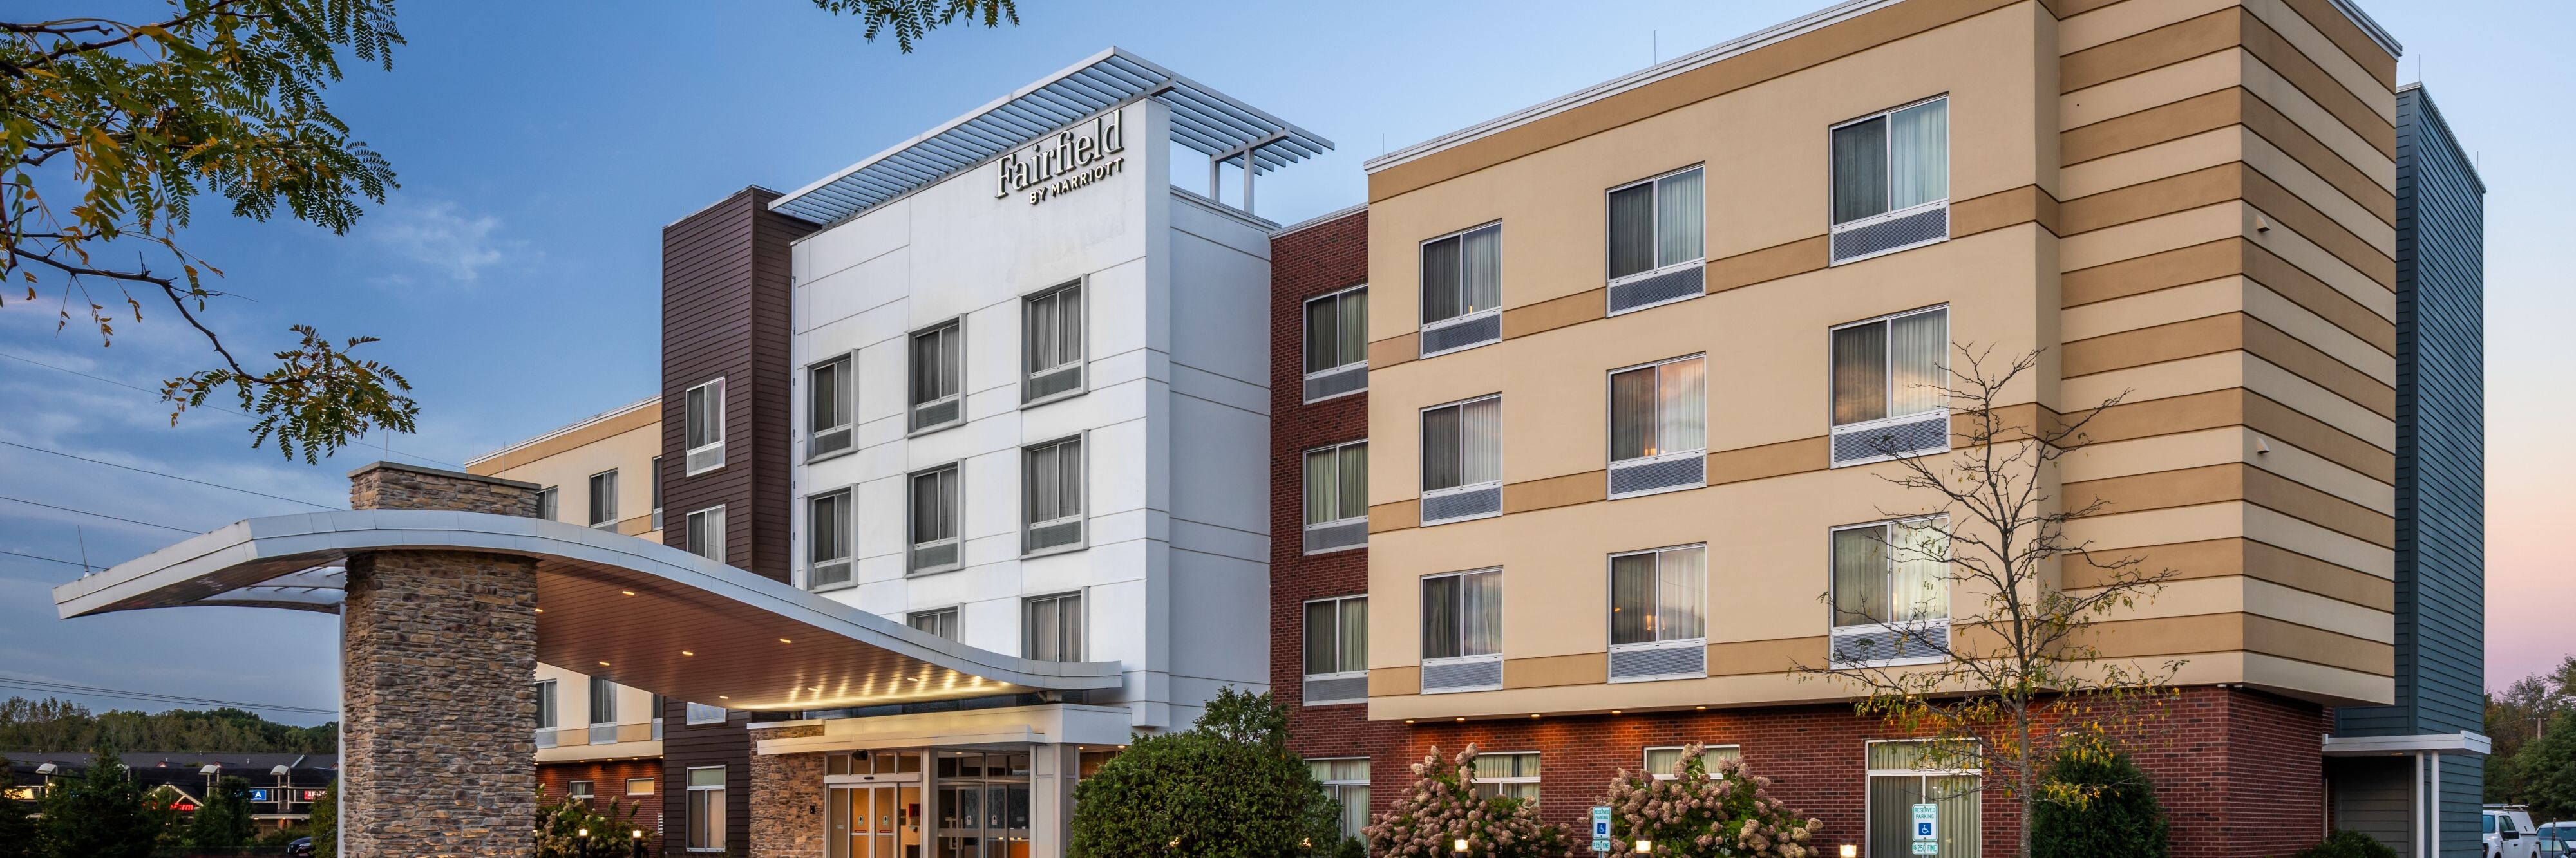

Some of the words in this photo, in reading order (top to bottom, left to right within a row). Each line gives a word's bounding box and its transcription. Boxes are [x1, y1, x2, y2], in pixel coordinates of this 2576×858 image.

[994, 109, 1124, 200] Fairfield
[1029, 187, 1048, 205] BY
[1050, 157, 1124, 197] MARRIOTT
